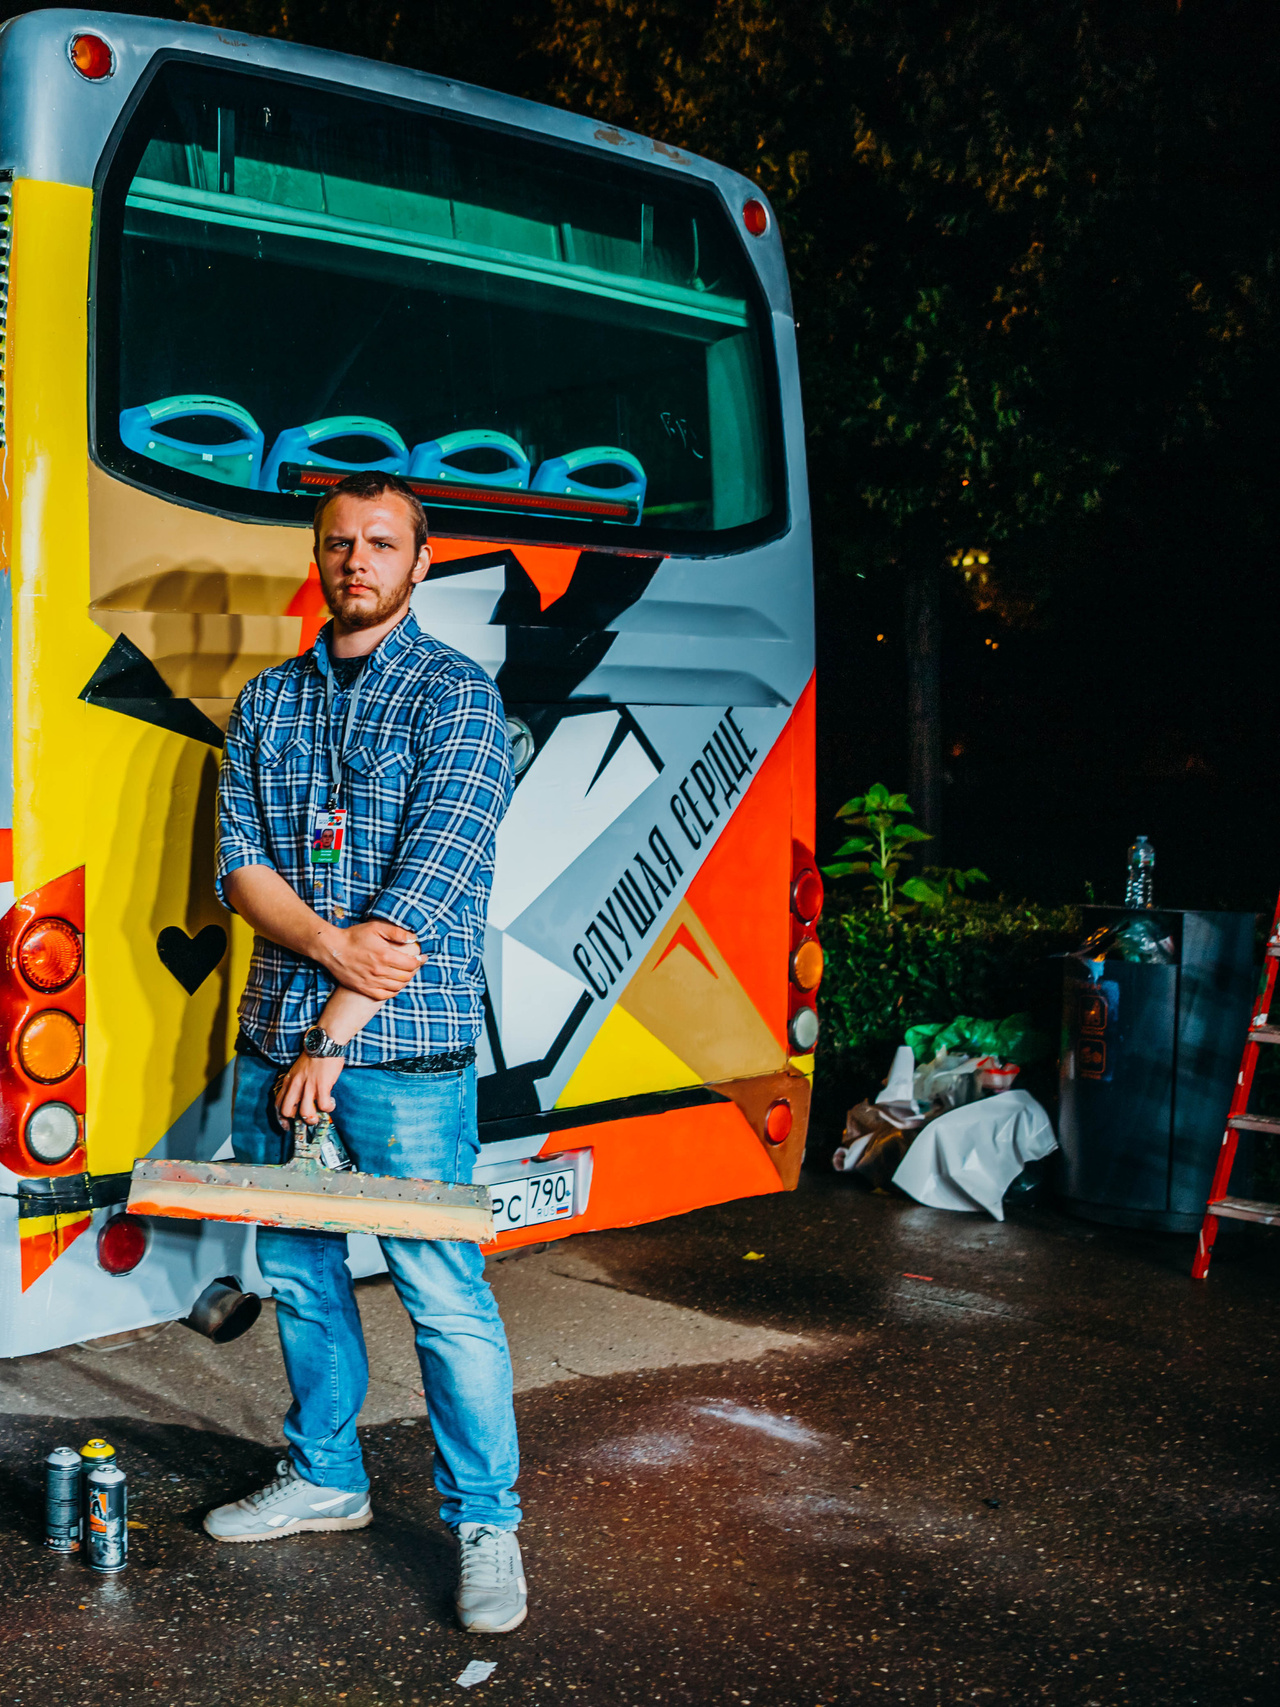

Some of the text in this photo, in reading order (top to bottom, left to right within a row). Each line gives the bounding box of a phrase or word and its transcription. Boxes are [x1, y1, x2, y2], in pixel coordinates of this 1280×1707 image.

[573, 706, 758, 1000] СЛУШАЯ СЕРДЦЕ
[530, 1176, 566, 1208] 790
[537, 1206, 555, 1217] RUS
